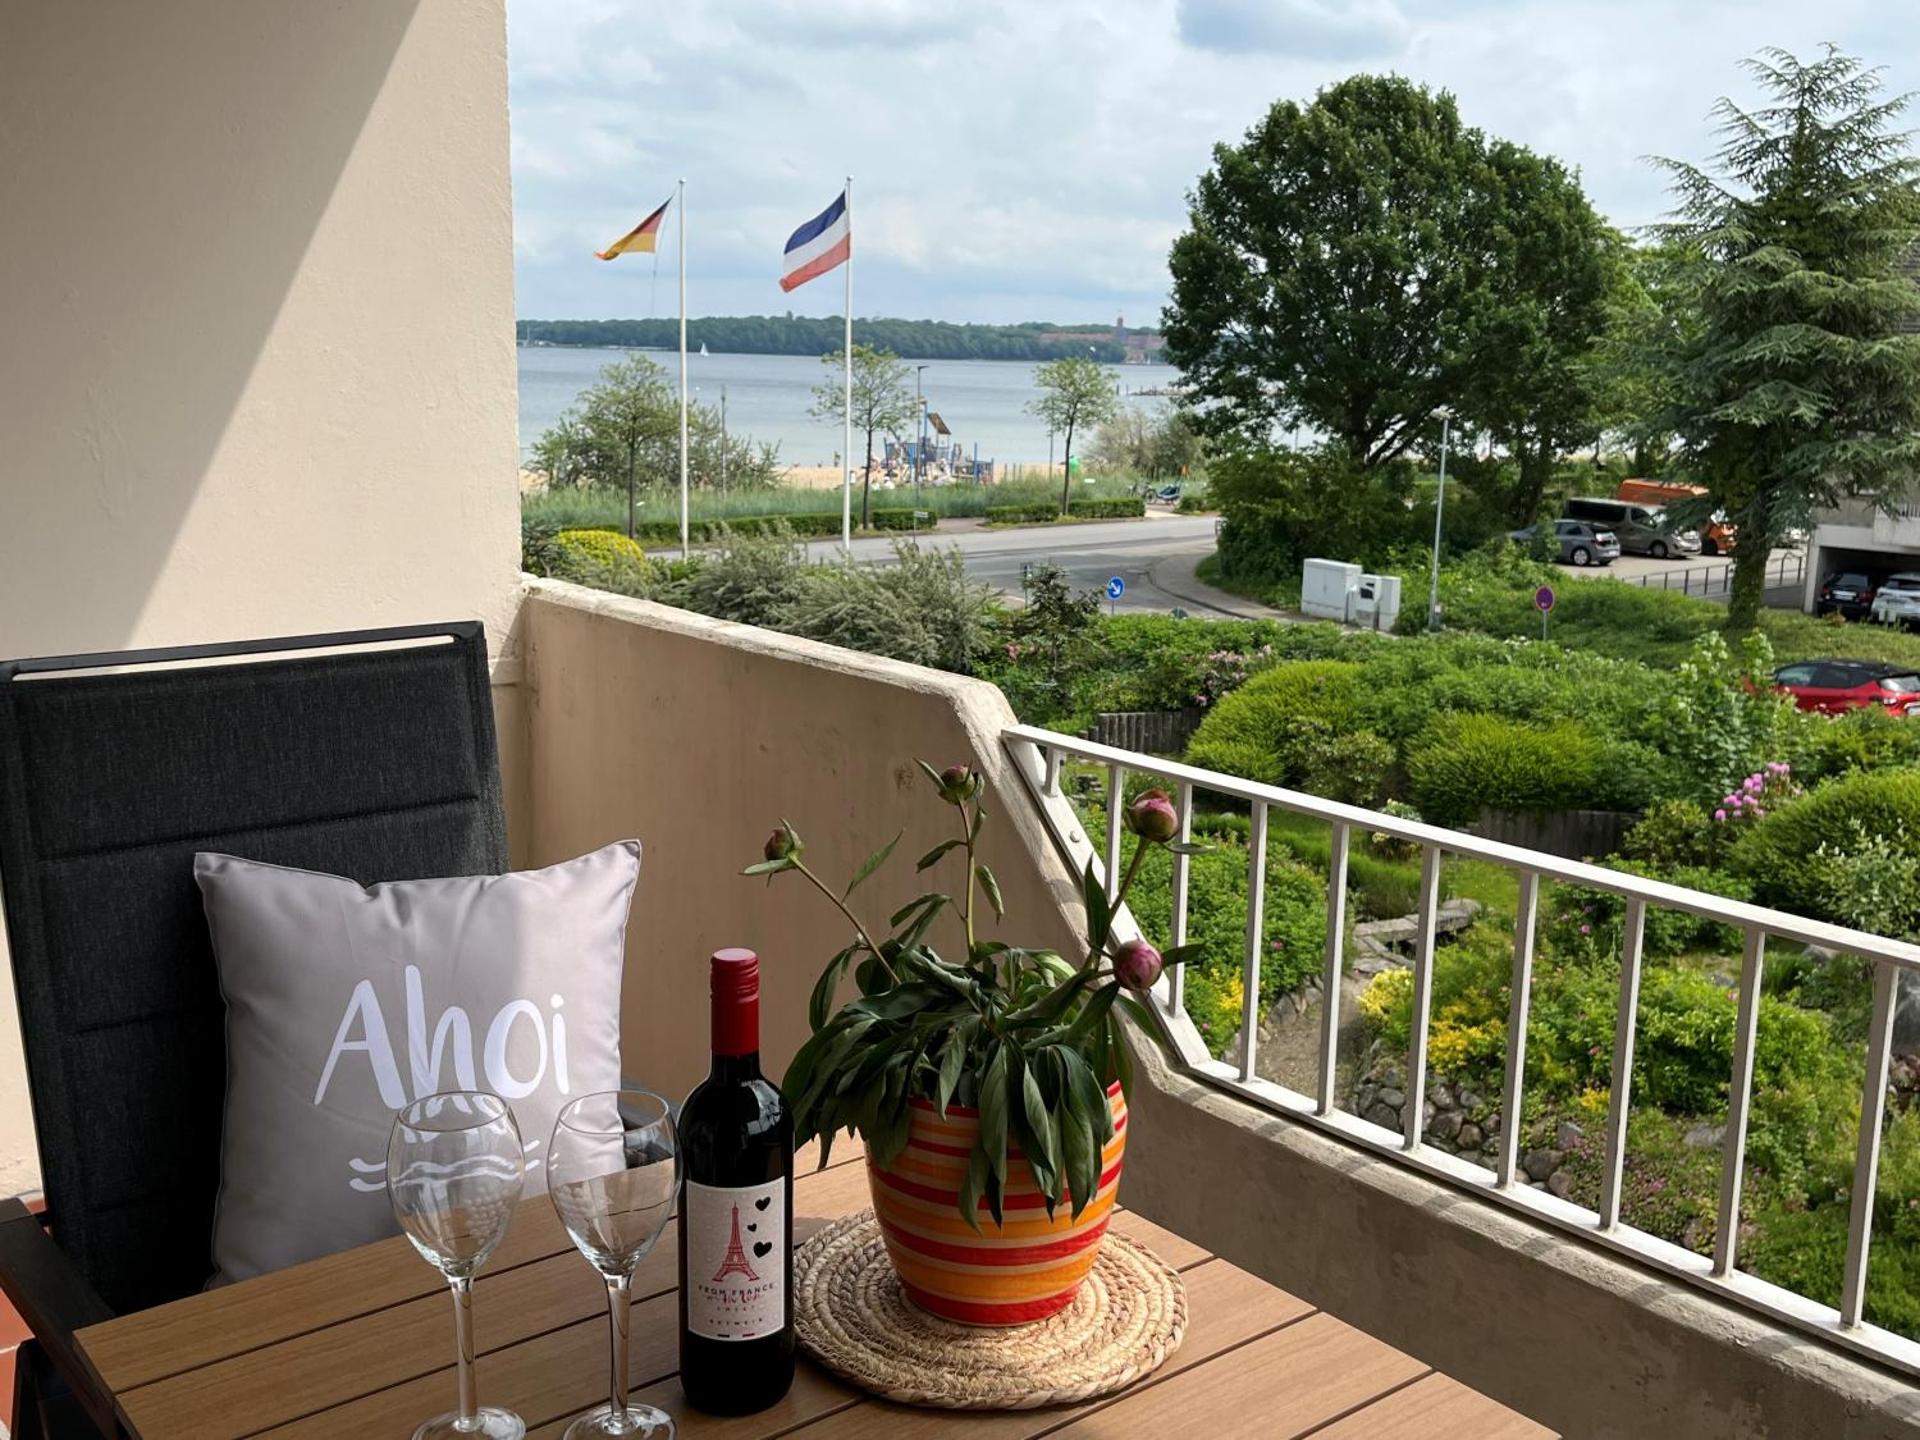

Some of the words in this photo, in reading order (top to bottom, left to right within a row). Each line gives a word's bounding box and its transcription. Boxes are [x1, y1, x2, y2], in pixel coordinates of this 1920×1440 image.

[314, 964, 570, 1123] Ahoi
[698, 1284, 726, 1295] FROM
[732, 1282, 773, 1296] FRANCE
